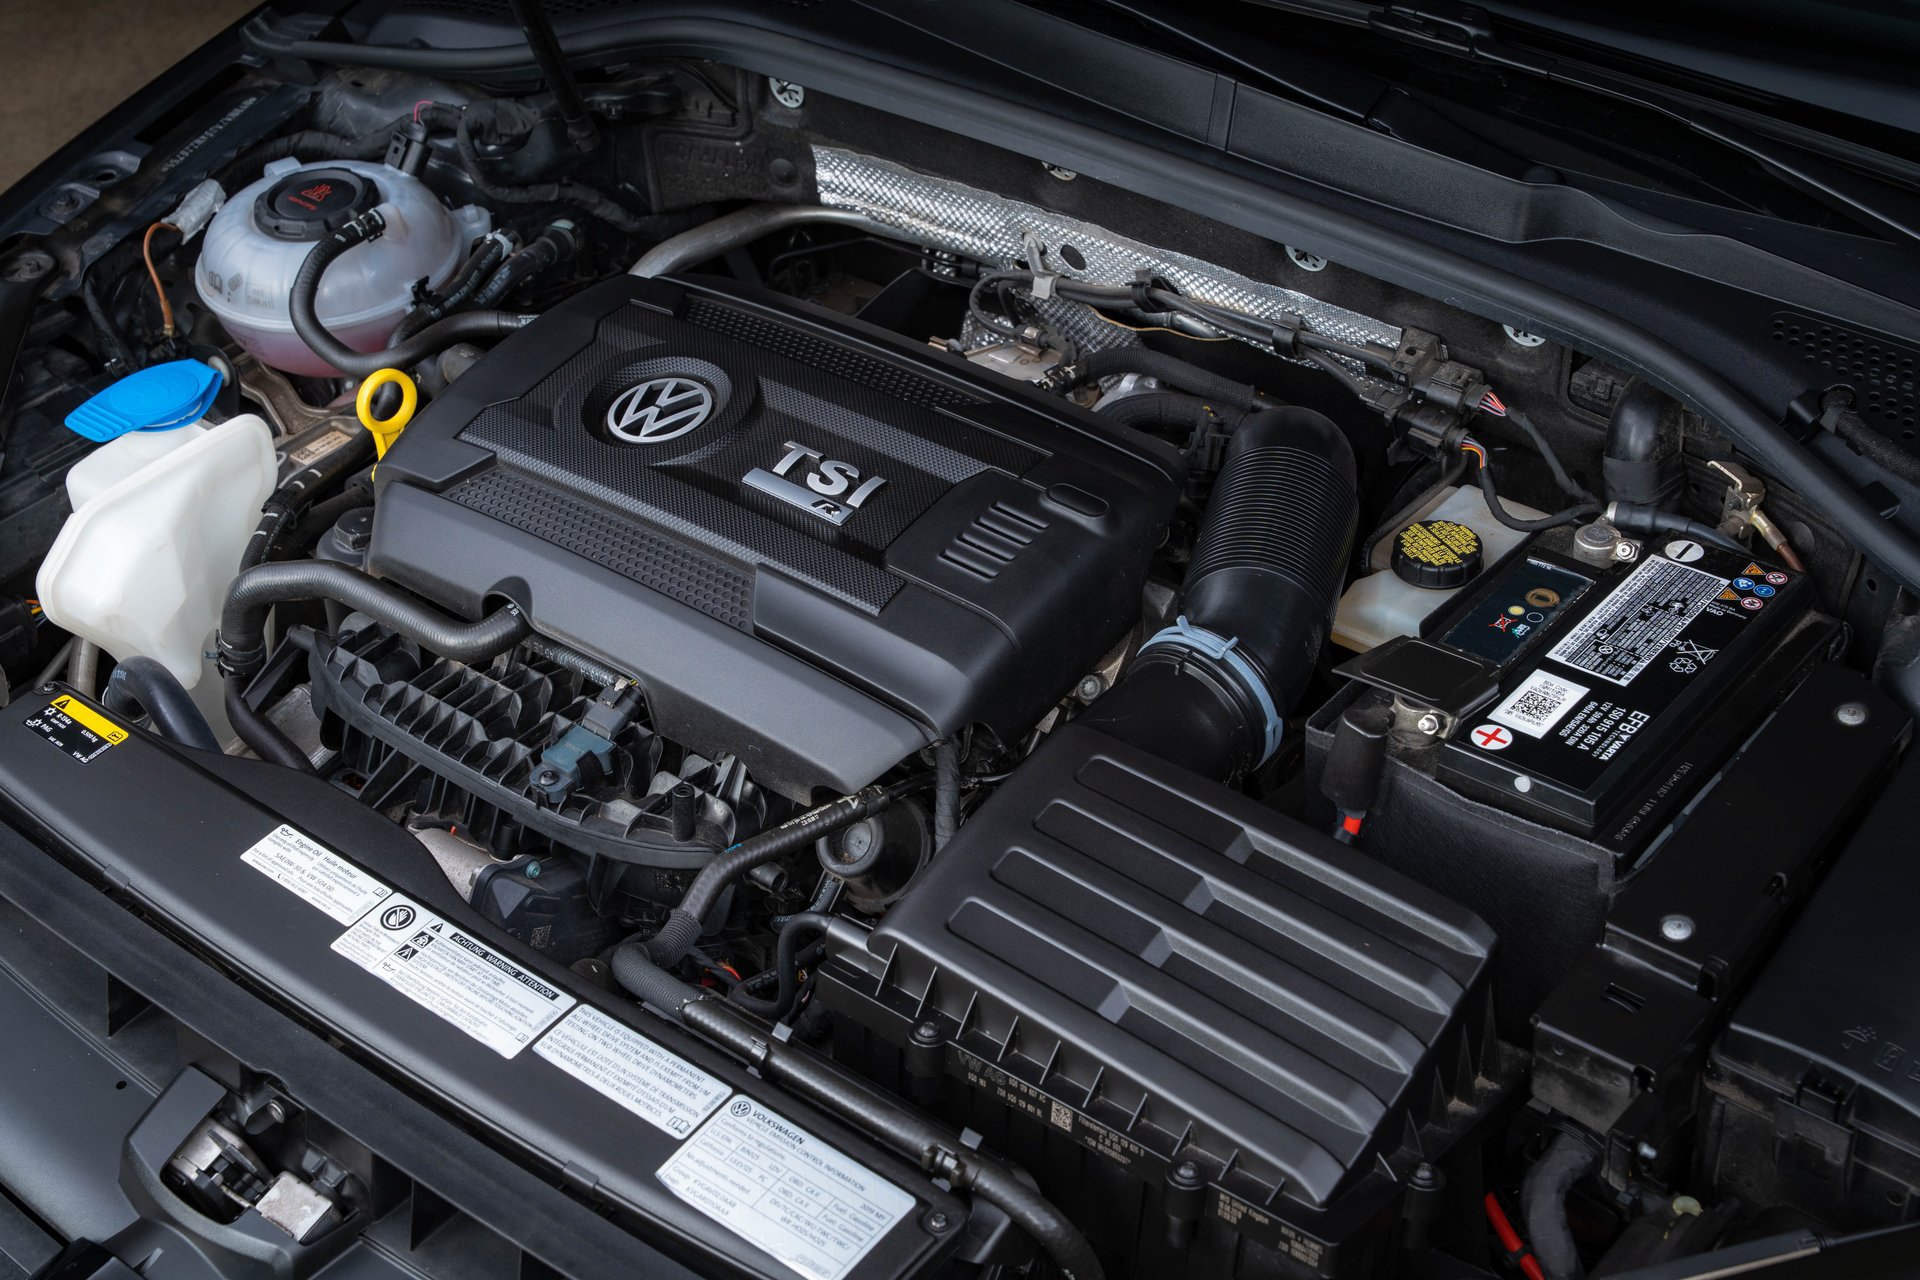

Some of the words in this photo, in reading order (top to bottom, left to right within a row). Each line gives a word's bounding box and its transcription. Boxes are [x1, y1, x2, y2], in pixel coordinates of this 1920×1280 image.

[770, 440, 887, 508] TSI
[1706, 607, 1724, 616] VAO
[1667, 639, 1683, 648] Pb
[1598, 702, 1614, 712] 12V
[1606, 707, 1628, 720] 1S0
[40, 724, 53, 732] PAG
[1594, 719, 1616, 733] 915
[1616, 711, 1651, 734] EFB
[1576, 743, 1592, 752] A
[1582, 731, 1604, 745] 105
[1589, 730, 1621, 757] TECHNOLOGY
[72, 751, 83, 759] VW
[1598, 740, 1625, 761] VARTA
[294, 839, 315, 853] Engine
[312, 849, 323, 857] Oil
[323, 857, 339, 868] Huile
[336, 866, 357, 880] moteur
[305, 873, 317, 881] VW
[315, 879, 327, 888] 504
[452, 935, 486, 957] ACHTUNG
[485, 955, 519, 976] WARNING
[517, 974, 556, 999] ATTENTION
[564, 1019, 590, 1036] TESTING
[587, 1032, 599, 1041] ON
[631, 1059, 652, 1072] DRIVE
[577, 1008, 593, 1018] THIS
[590, 1015, 616, 1031] VEHICLE
[619, 1032, 651, 1051] EQUIPPED
[647, 1048, 666, 1060] WITH
[668, 1060, 707, 1084] PERMANENT
[540, 1040, 554, 1051] SUR
[598, 1076, 617, 1089] DEUX
[613, 1085, 637, 1101] ROUES
[573, 1051, 608, 1073] PERMANENT
[605, 1070, 616, 1078] ET
[601, 1031, 620, 1044] DRIVE
[618, 1041, 641, 1056] SYSTEM
[639, 1053, 655, 1064] AND
[659, 1065, 683, 1080] EXEMPT
[681, 1078, 701, 1091] FROM
[957, 1050, 982, 1072] VW
[984, 1067, 1007, 1086] AG
[553, 1028, 563, 1036] CE
[586, 1048, 599, 1057] EST
[648, 1085, 660, 1094] DE
[657, 1090, 701, 1119] TRANSMISSION
[719, 1118, 749, 1137] Conforms
[751, 1111, 806, 1145] VOLKSWAGEN
[745, 1118, 770, 1134] VEHICLE
[768, 1131, 798, 1150] EMISSION
[795, 1148, 825, 1167] CONTROL
[822, 1164, 867, 1192] INFORMATION
[804, 1187, 816, 1195] CA
[794, 1197, 806, 1206] CA
[859, 1203, 876, 1215] 2019
[873, 1212, 887, 1221] MY
[848, 1213, 876, 1232] Gasoline
[837, 1224, 865, 1243] Gasoline
